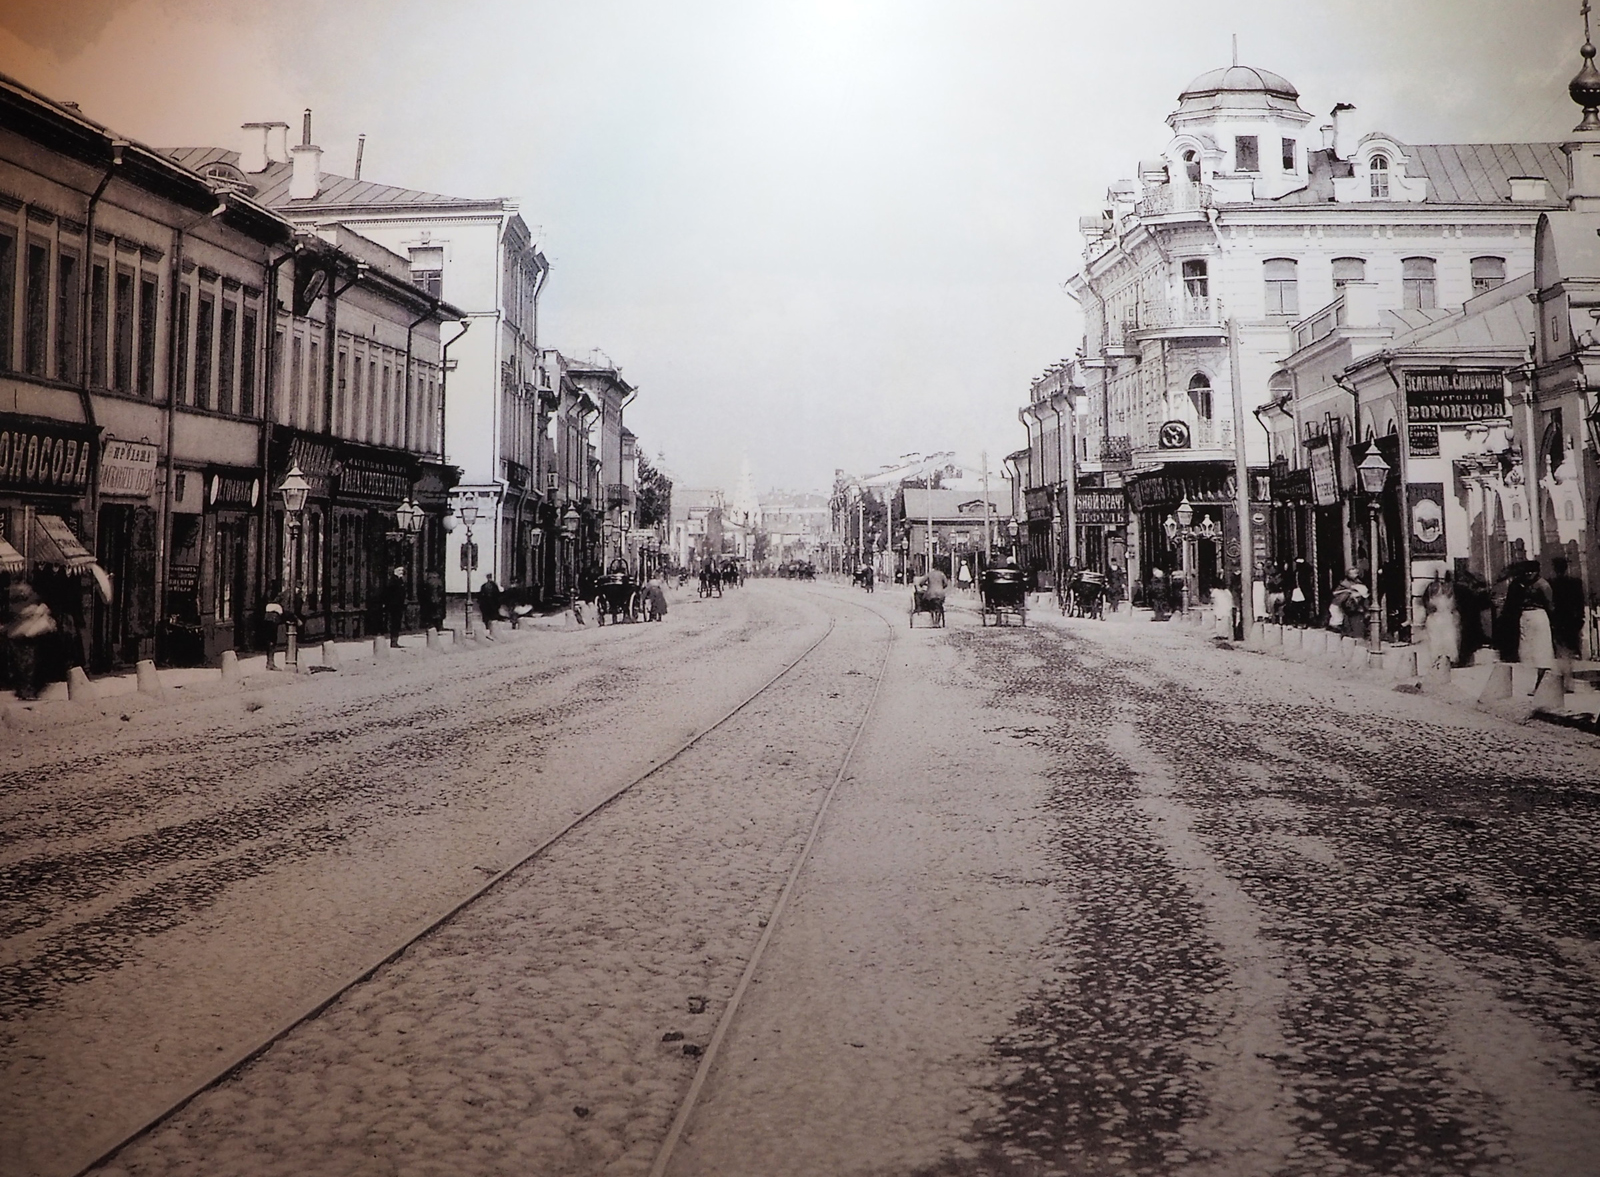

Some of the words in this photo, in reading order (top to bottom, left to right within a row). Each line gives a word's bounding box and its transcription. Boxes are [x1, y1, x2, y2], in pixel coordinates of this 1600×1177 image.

[1408, 403, 1504, 420] ВОРОНЦОВА
[0, 431, 90, 487] ОНОСОВА
[1075, 492, 1099, 510] БНОЙ
